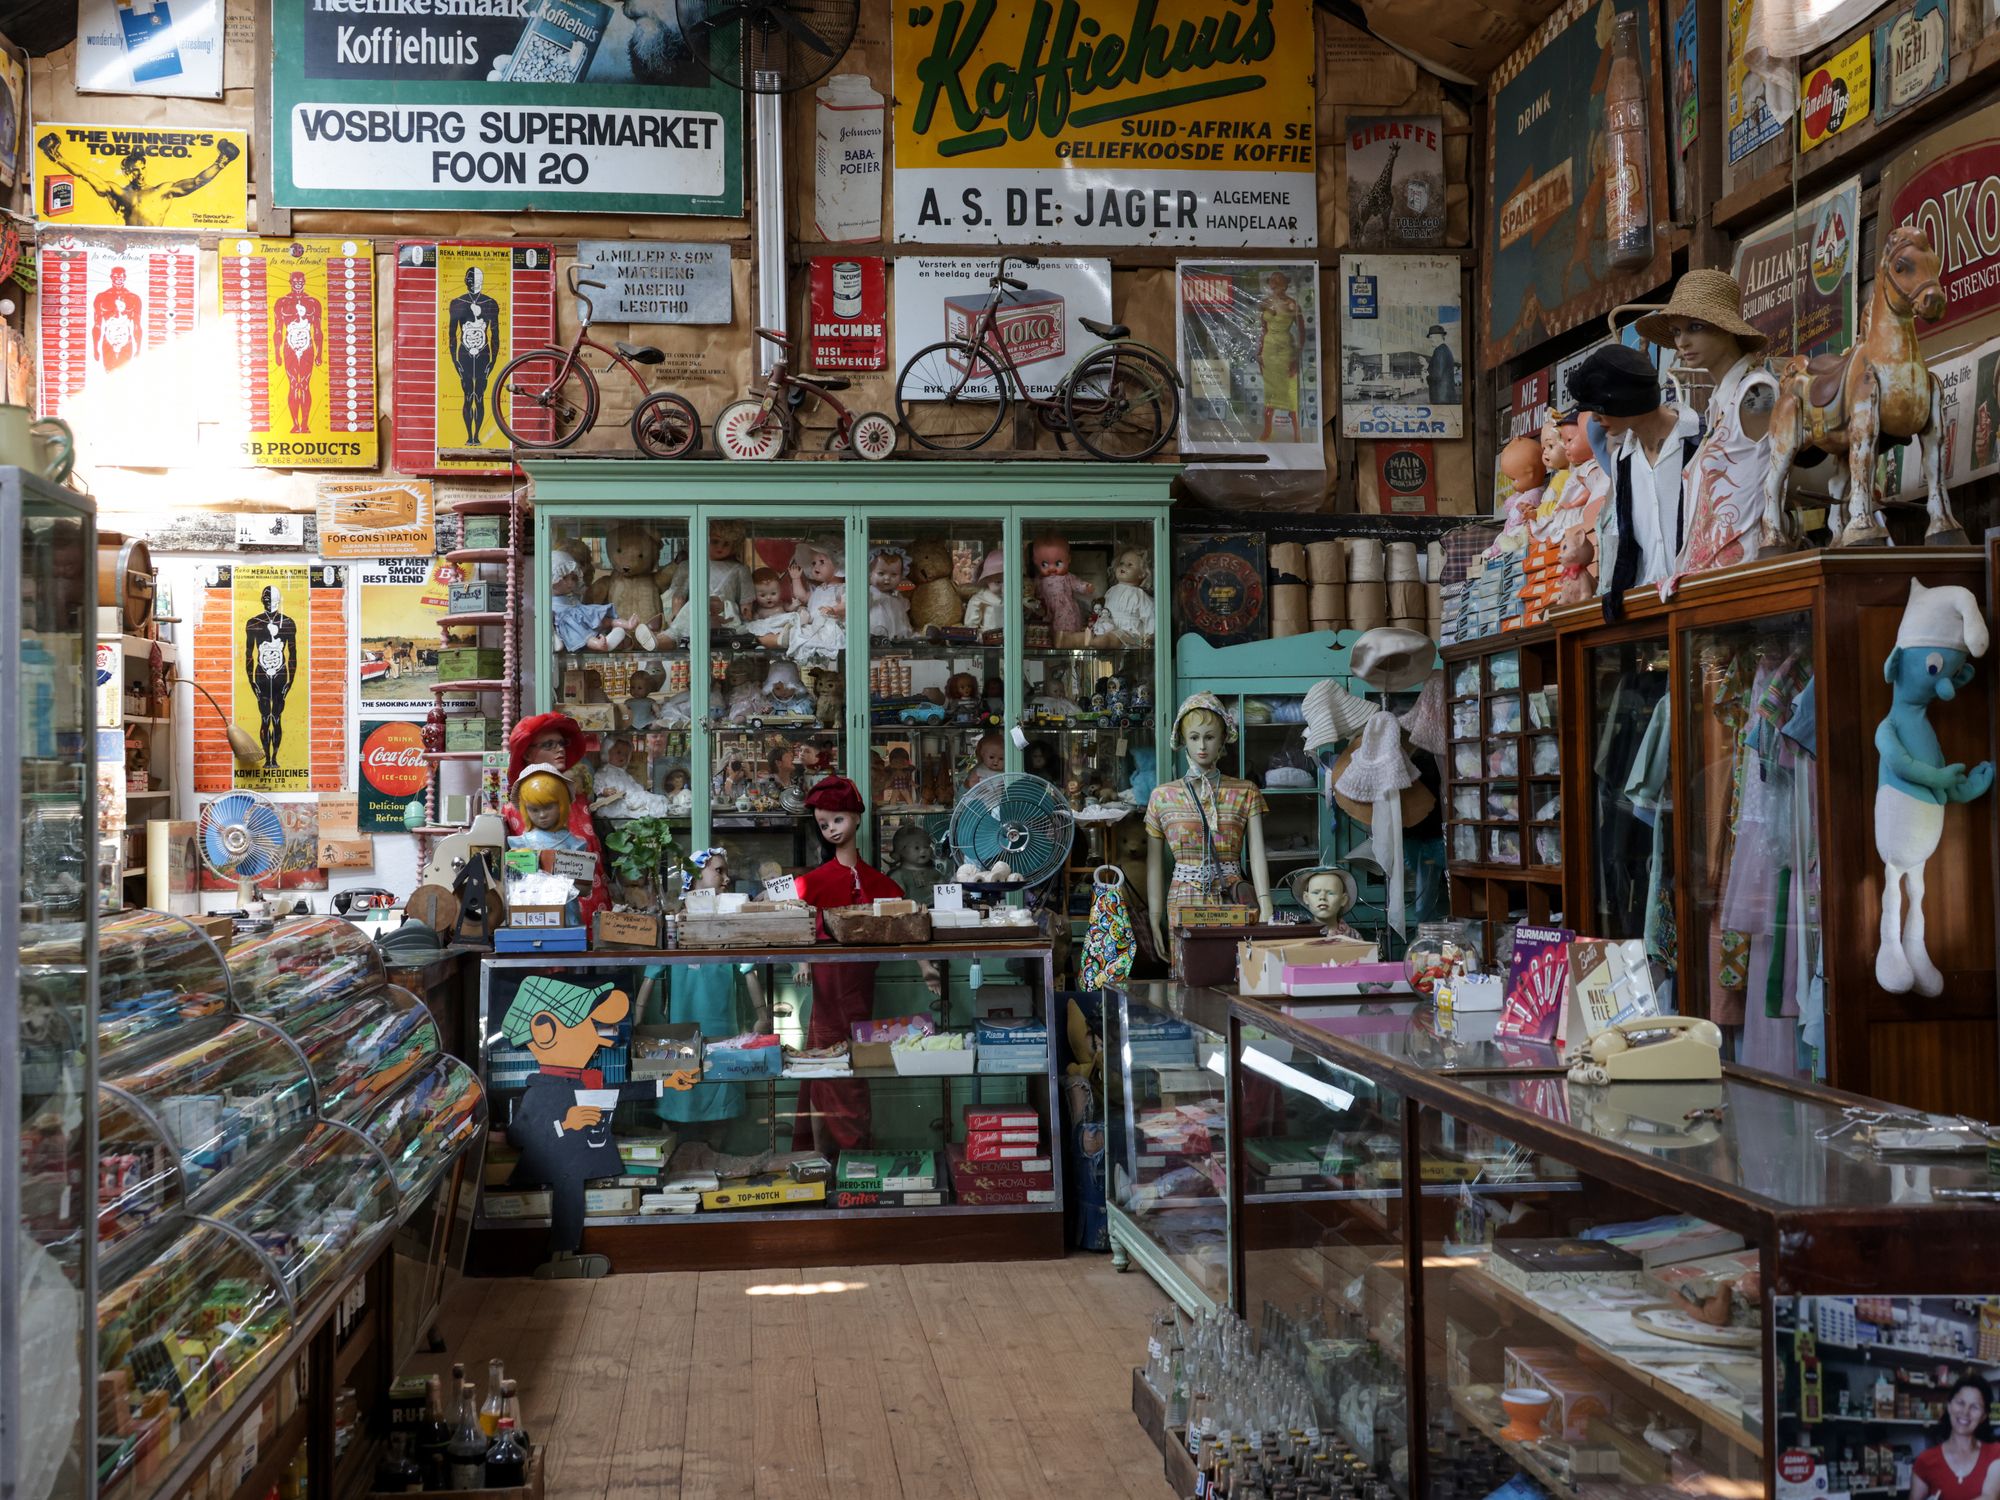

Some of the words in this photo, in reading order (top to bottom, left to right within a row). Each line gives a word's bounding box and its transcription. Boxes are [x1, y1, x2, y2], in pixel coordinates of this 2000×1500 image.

[86, 32, 124, 48] wonderfully
[337, 25, 478, 65] Koffiehuis
[1895, 31, 1927, 77] NEHI
[1517, 88, 1551, 136] DRINK
[299, 109, 465, 143] VOSBURG
[478, 111, 718, 151] SUPERMARKET
[1830, 118, 1840, 129] TEA
[840, 127, 881, 143] Johnson's
[1120, 120, 1272, 140] SUID-AFRIKA
[1284, 122, 1312, 141] SE
[1352, 122, 1437, 151] GIRAFFE
[66, 130, 107, 143] THE
[112, 131, 214, 146] WINNER'S
[87, 143, 192, 158] TOBACCO.
[845, 150, 876, 161] BABA-
[1055, 142, 1224, 161] GELIEFKOOSDE
[1233, 143, 1312, 163] KOFFIE
[432, 151, 526, 184] FOON
[538, 153, 589, 185] 20
[840, 162, 880, 175] POEIER
[1212, 190, 1290, 205] ALGEMENE
[1074, 190, 1198, 228] JAGER
[1502, 174, 1569, 235] SPARLETTA
[1205, 215, 1299, 231] HANDELAAR
[1396, 217, 1440, 227] TOBACCO
[1901, 175, 2000, 277] OKO
[1402, 228, 1433, 239] TABAK
[305, 244, 330, 253] Product
[670, 252, 681, 262] &
[685, 252, 713, 264] SON
[919, 260, 957, 269] Versterk
[1008, 260, 1022, 270] jou
[617, 266, 694, 279] MATSIENG
[1951, 263, 2000, 302] STRENGT
[624, 283, 685, 296] MASERU
[1182, 279, 1229, 301] DRUM
[1743, 290, 1775, 320] BUILDING
[1777, 275, 1807, 305] SOCITY
[619, 300, 688, 313] LESOTHO
[813, 324, 881, 337] INCUMBE
[1003, 319, 1049, 345] JOKO
[818, 347, 840, 356] BISI
[815, 357, 881, 367] NESWEKILE
[1960, 365, 1972, 383] life
[950, 385, 990, 393] GURIG.
[1521, 377, 1538, 408] NIE
[1360, 421, 1445, 433] DOLLAR
[267, 442, 361, 456] PRODUCTS
[1389, 456, 1420, 468] MAIN
[1391, 468, 1421, 480] LINE
[349, 533, 428, 543] CONSTIPATION
[378, 558, 404, 566] BEST
[405, 558, 429, 566] MEN
[388, 567, 426, 575] SMOKE
[362, 575, 387, 583] BEST
[389, 575, 424, 584] BLEND
[368, 747, 428, 767] Coca-Cola
[234, 769, 261, 778] KOWIE
[263, 769, 309, 777] MEDICINES
[321, 811, 334, 819] SS
[376, 813, 404, 822] Refres
[938, 886, 943, 896] R
[946, 886, 956, 894] 65
[1516, 928, 1561, 943] SURMANCO
[1587, 987, 1608, 1006] NAIL
[1591, 1005, 1611, 1022] FILE
[982, 1162, 1019, 1171] ROYALS
[998, 1178, 1036, 1187] ROYALS
[737, 1192, 780, 1202] TOP-NOTCH
[985, 1192, 1024, 1201] ROYALS
